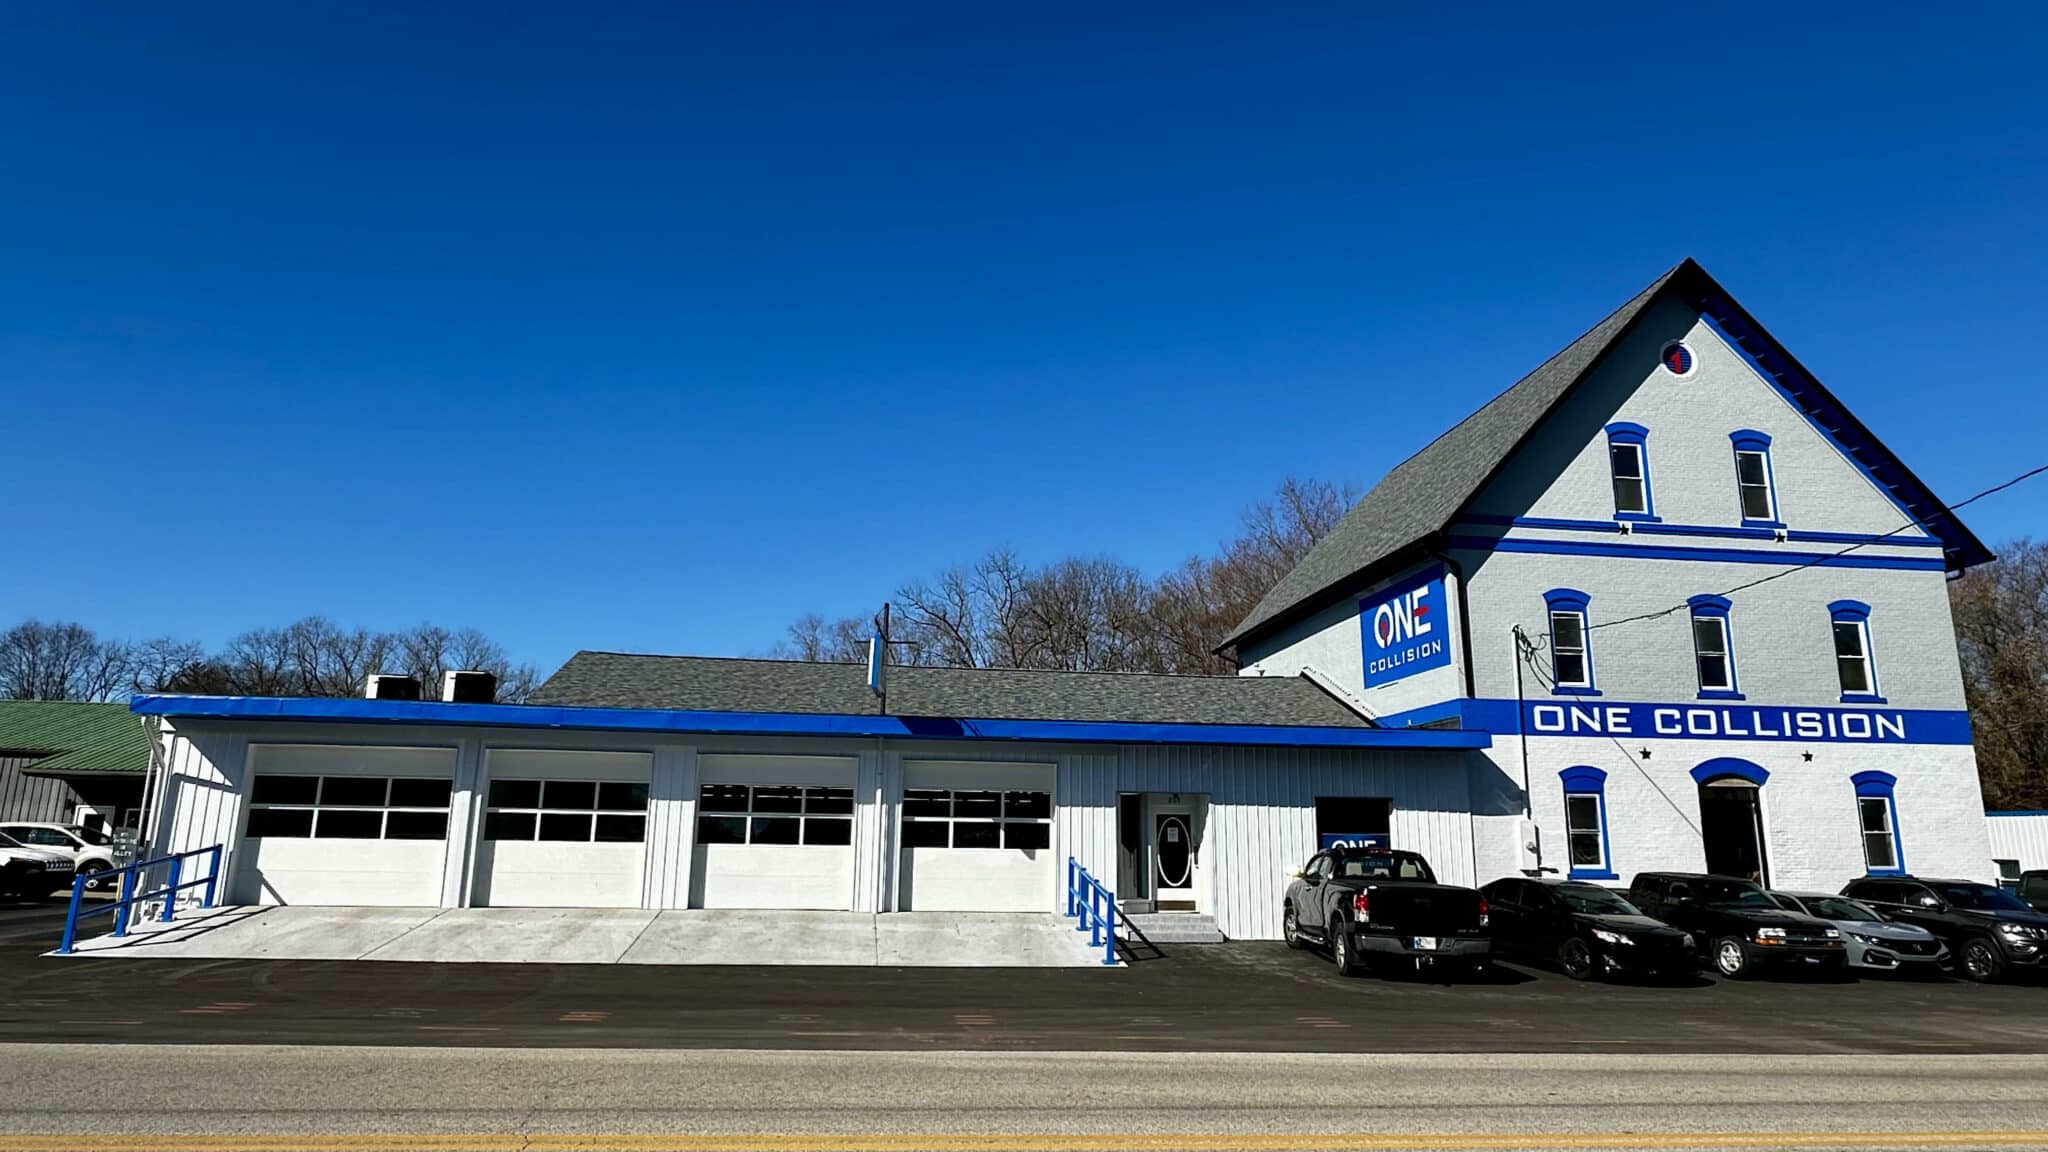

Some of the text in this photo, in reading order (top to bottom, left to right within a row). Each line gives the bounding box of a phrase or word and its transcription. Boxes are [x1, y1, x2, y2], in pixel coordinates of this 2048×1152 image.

[1374, 585, 1431, 649] ONE
[1370, 639, 1441, 674] COLLISION
[1533, 705, 1906, 739] ONE COLLISION
